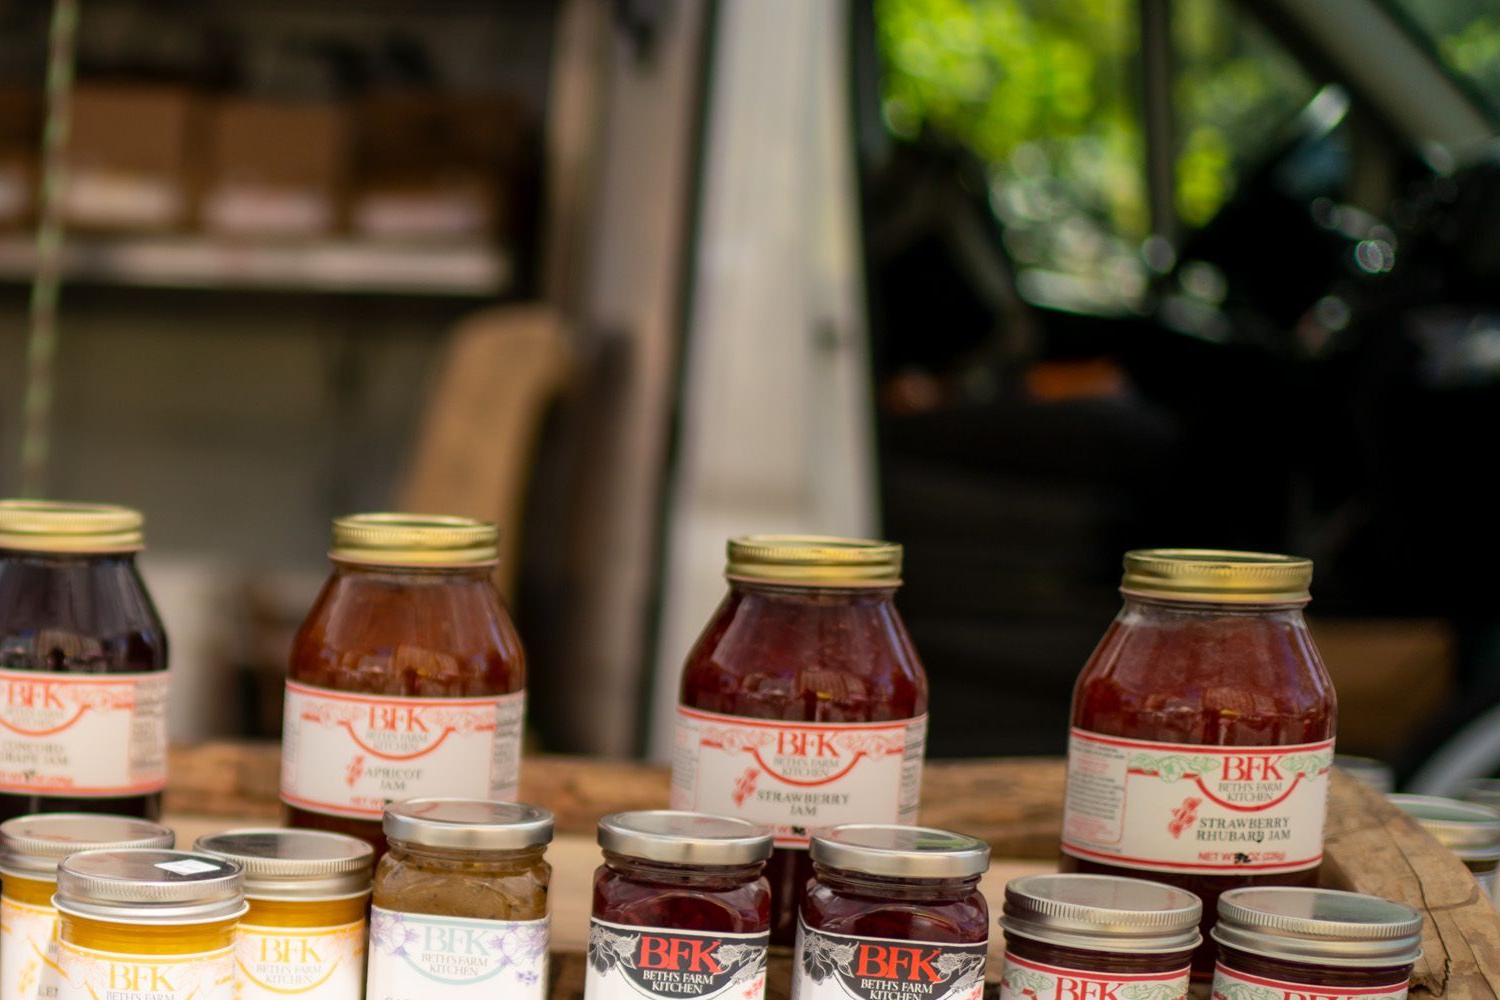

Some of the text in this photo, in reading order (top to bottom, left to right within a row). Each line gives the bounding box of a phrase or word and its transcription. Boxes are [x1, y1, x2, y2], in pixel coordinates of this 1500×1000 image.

[368, 706, 429, 732] BFK
[776, 730, 839, 758] BFK
[365, 767, 423, 779] APRICOT
[1221, 756, 1283, 782] BFK
[380, 779, 406, 791] JAM
[1218, 782, 1283, 792] BETH'S FARM
[757, 790, 850, 805] STRAWBERRY
[1227, 791, 1274, 802] KITCHEN
[790, 805, 817, 817] JAM
[1199, 816, 1291, 829] STRAWBERRY
[1196, 829, 1292, 842] RHUBARB JAM
[424, 927, 490, 956] BFK
[261, 938, 321, 963] BFK
[638, 936, 723, 974] BFK
[422, 953, 488, 967] BETH'S FARM
[856, 944, 942, 983] BFK
[109, 963, 175, 992] BFK
[430, 964, 478, 976] KITCHEN
[643, 970, 713, 985] BETH'S FARM
[652, 980, 703, 994] KITCHEN
[861, 979, 933, 994] BETH'S FARM
